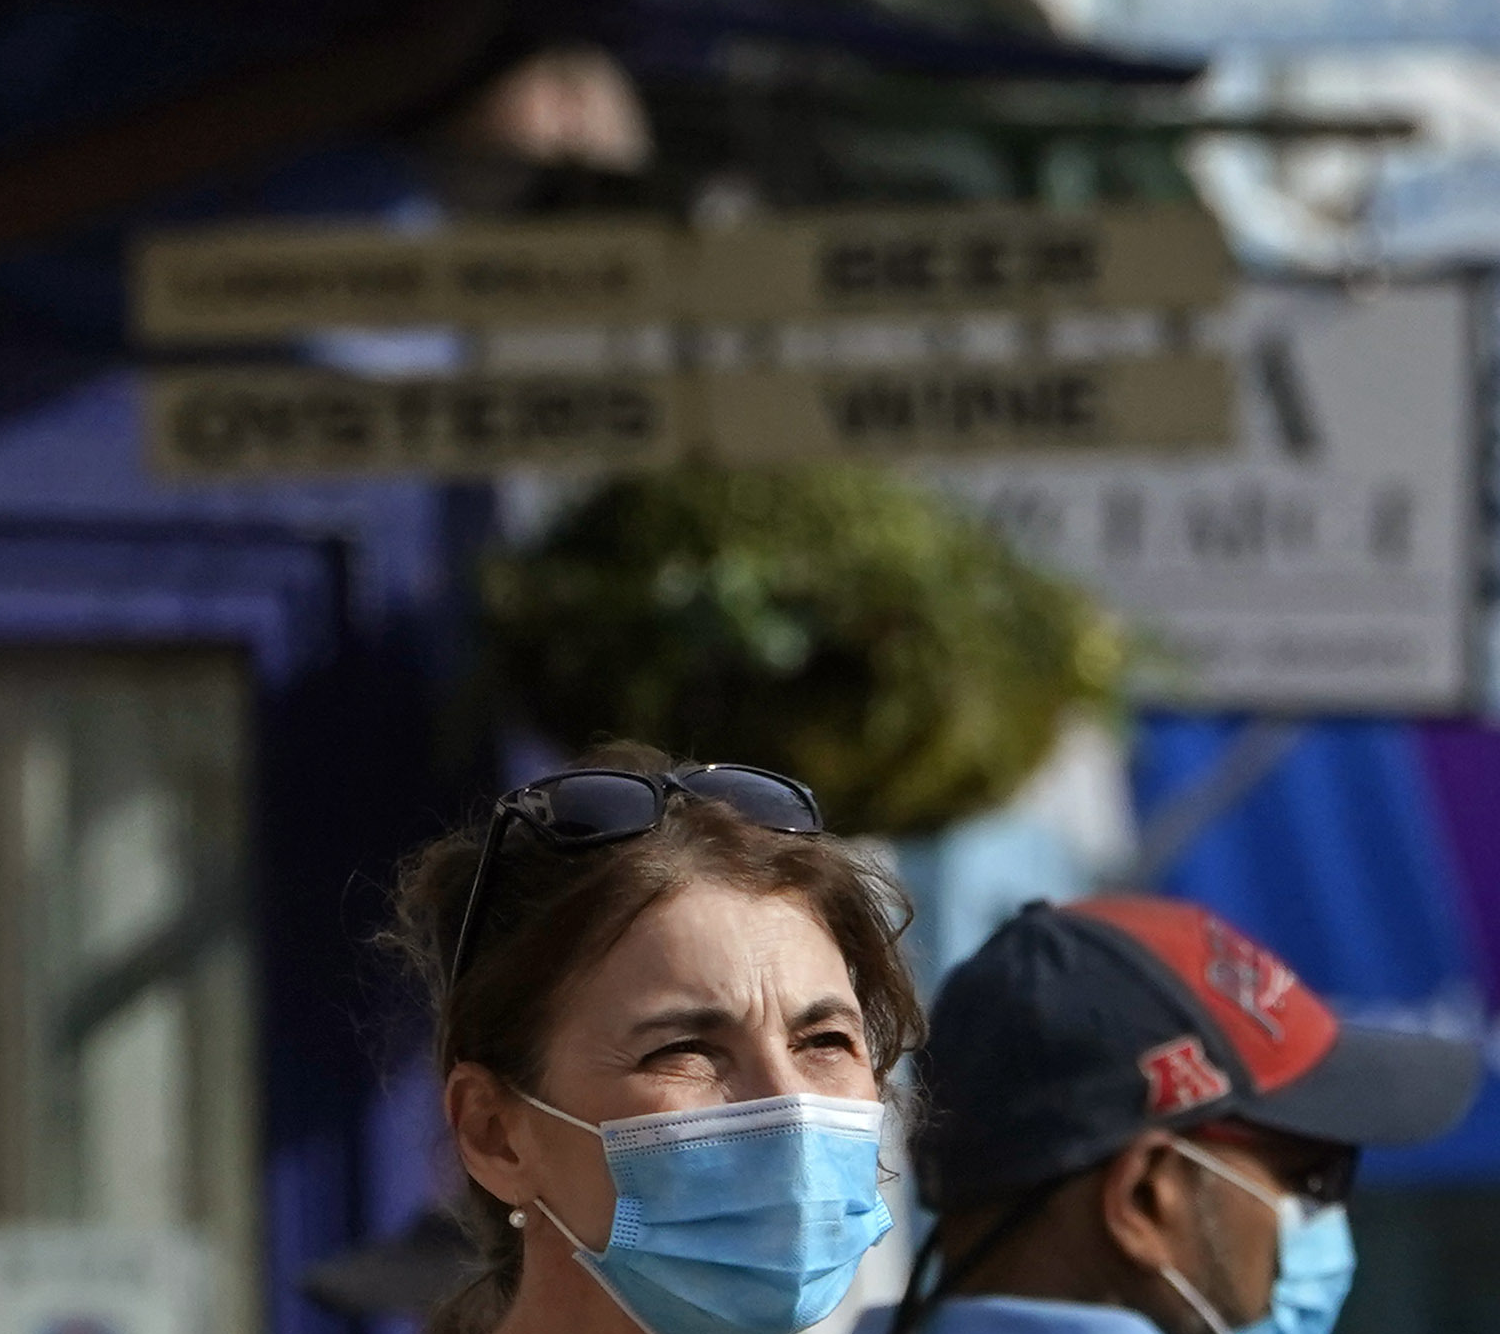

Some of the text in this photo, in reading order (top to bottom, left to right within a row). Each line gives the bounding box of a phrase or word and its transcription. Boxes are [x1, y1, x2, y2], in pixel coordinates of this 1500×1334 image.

[818, 239, 1098, 297] BEER
[172, 382, 658, 460] OYSTERS
[822, 375, 1100, 437] WINE
